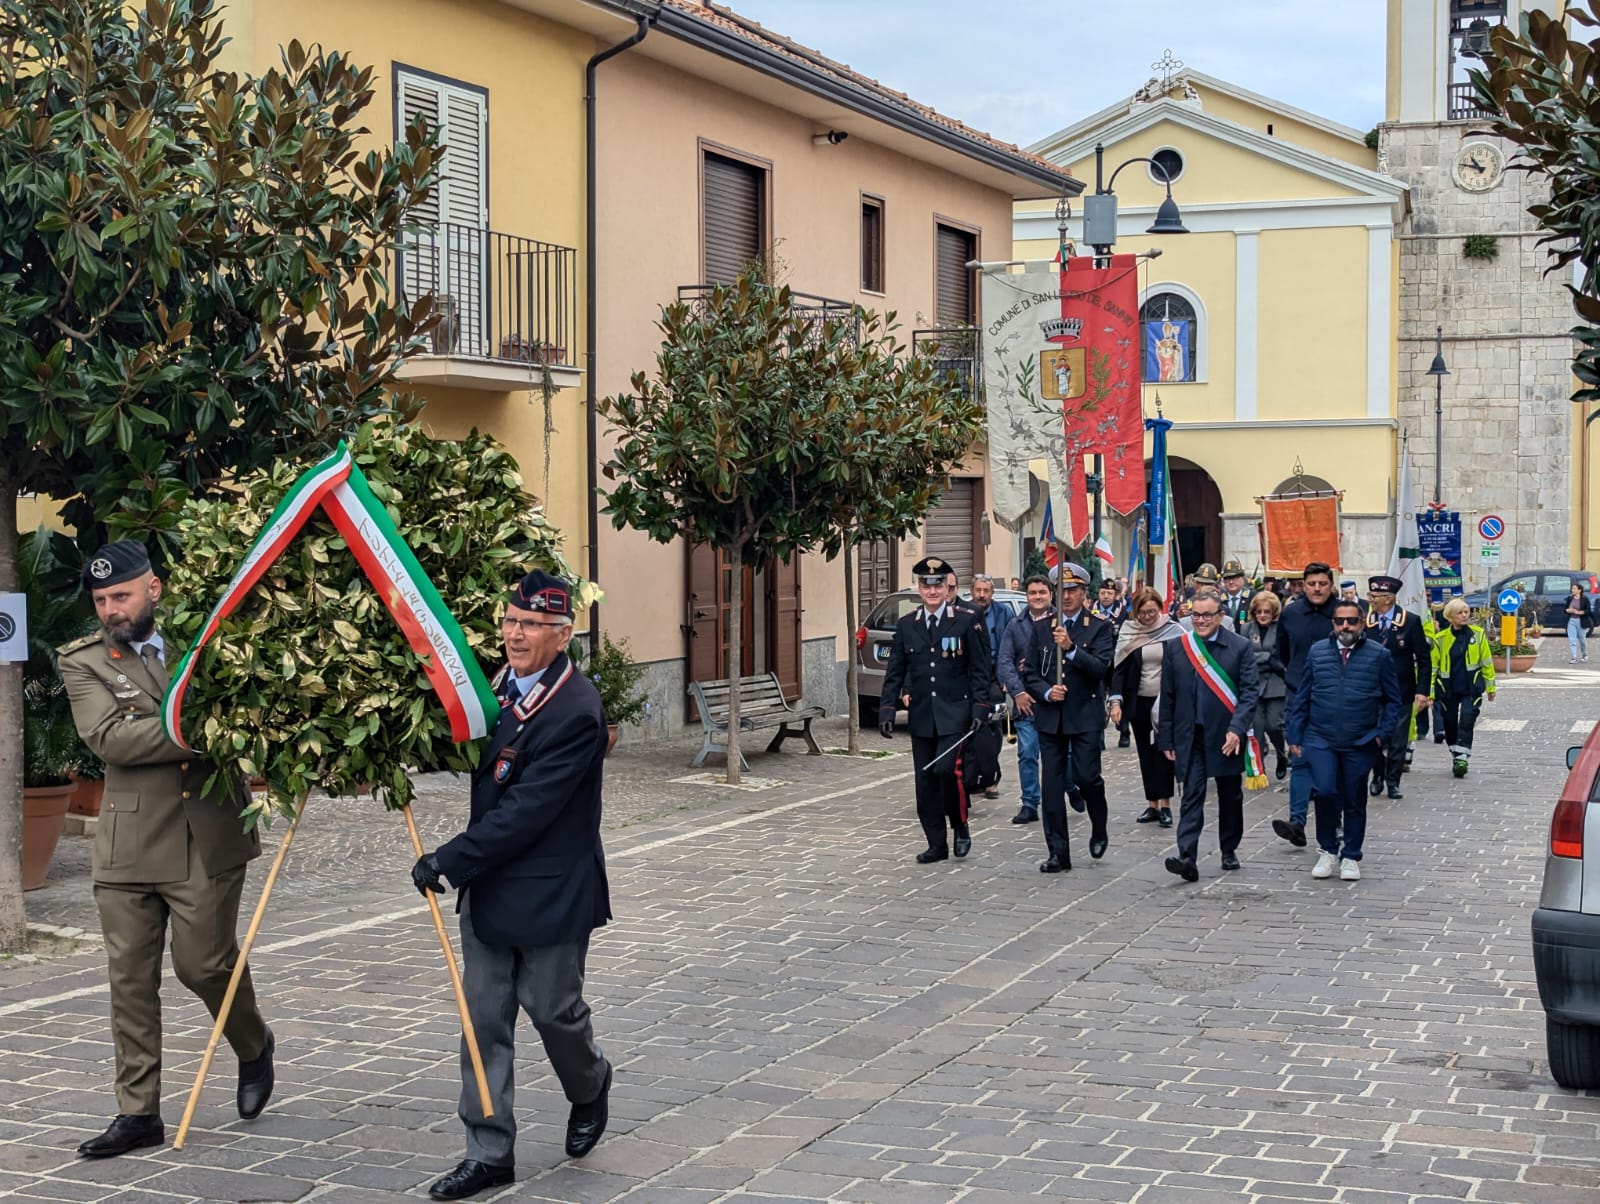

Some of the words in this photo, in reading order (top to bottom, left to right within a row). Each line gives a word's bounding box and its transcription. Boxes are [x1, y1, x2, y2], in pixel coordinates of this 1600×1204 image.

[988, 303, 1023, 336] COMUNE
[1020, 299, 1032, 311] DI
[1032, 290, 1051, 306] SAN
[1417, 523, 1455, 534] ANCRI
[414, 608, 468, 688] GUERRE
